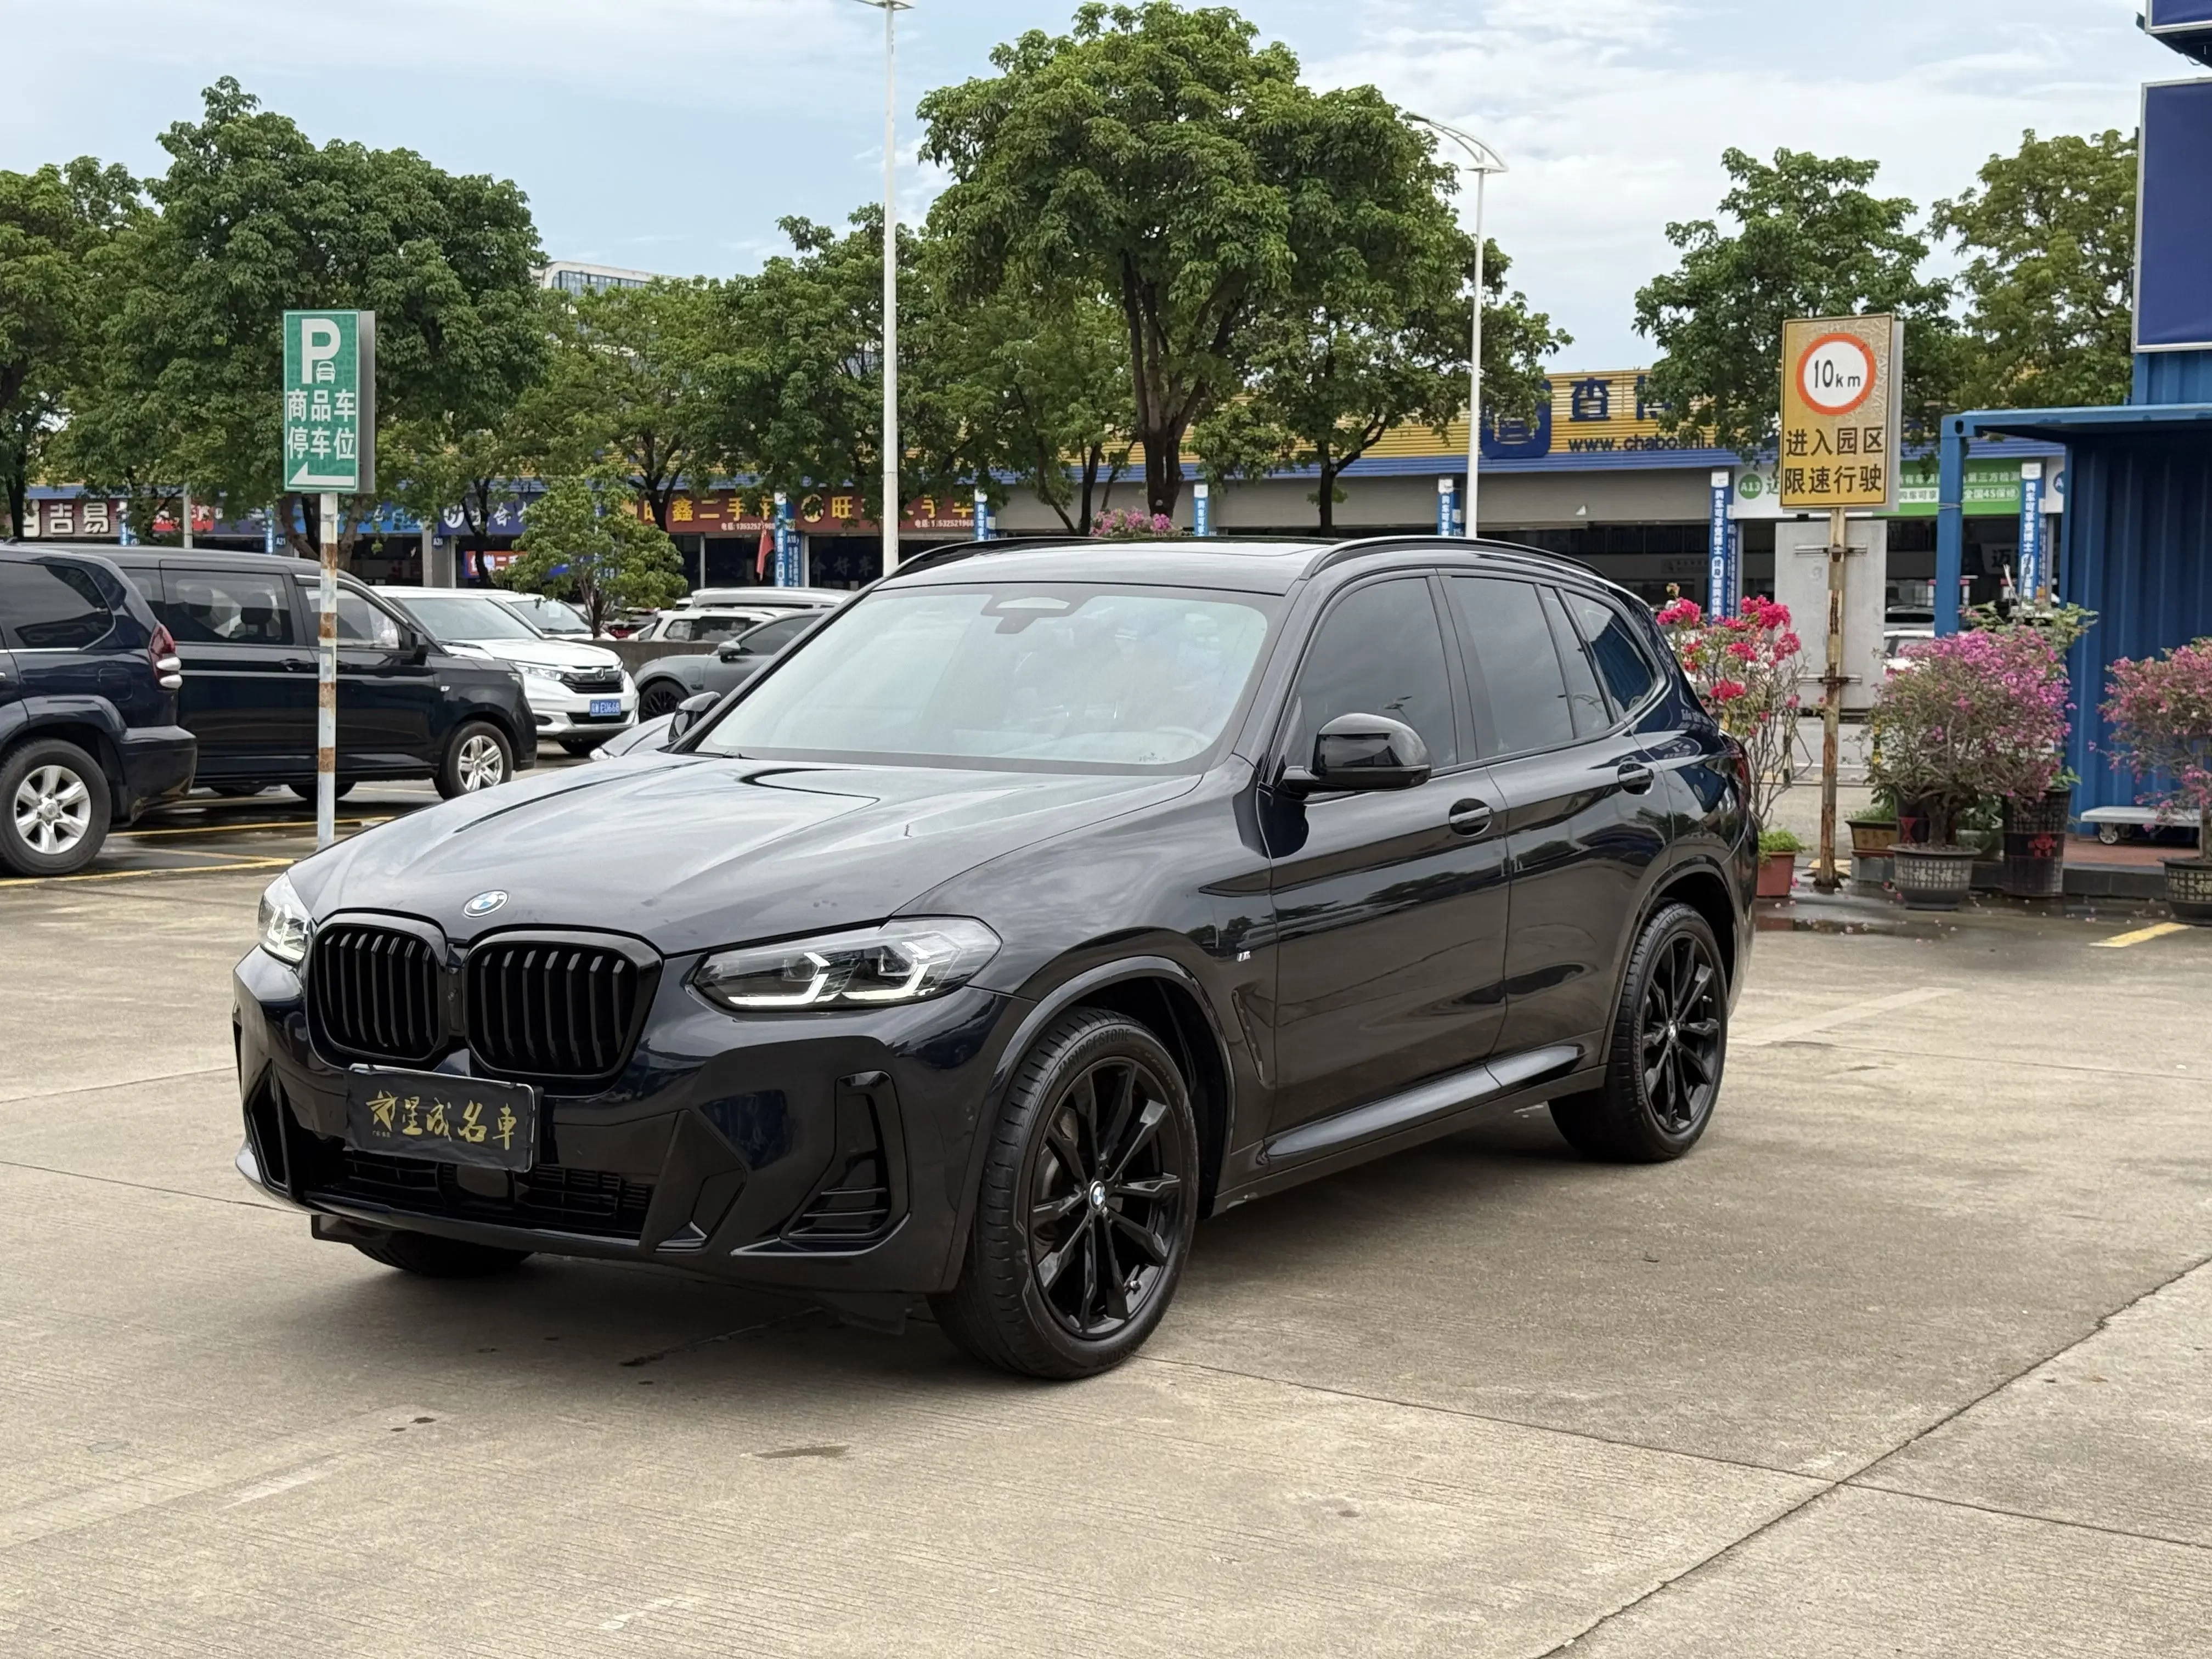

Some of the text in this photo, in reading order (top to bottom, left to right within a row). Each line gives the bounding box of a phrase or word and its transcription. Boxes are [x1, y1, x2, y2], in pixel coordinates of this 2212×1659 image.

[301, 318, 341, 384] P
[287, 388, 356, 422] 商品车
[287, 426, 356, 460] 停车位
[1786, 426, 1884, 457] 进入园区
[1785, 463, 1883, 496] 限速行驶
